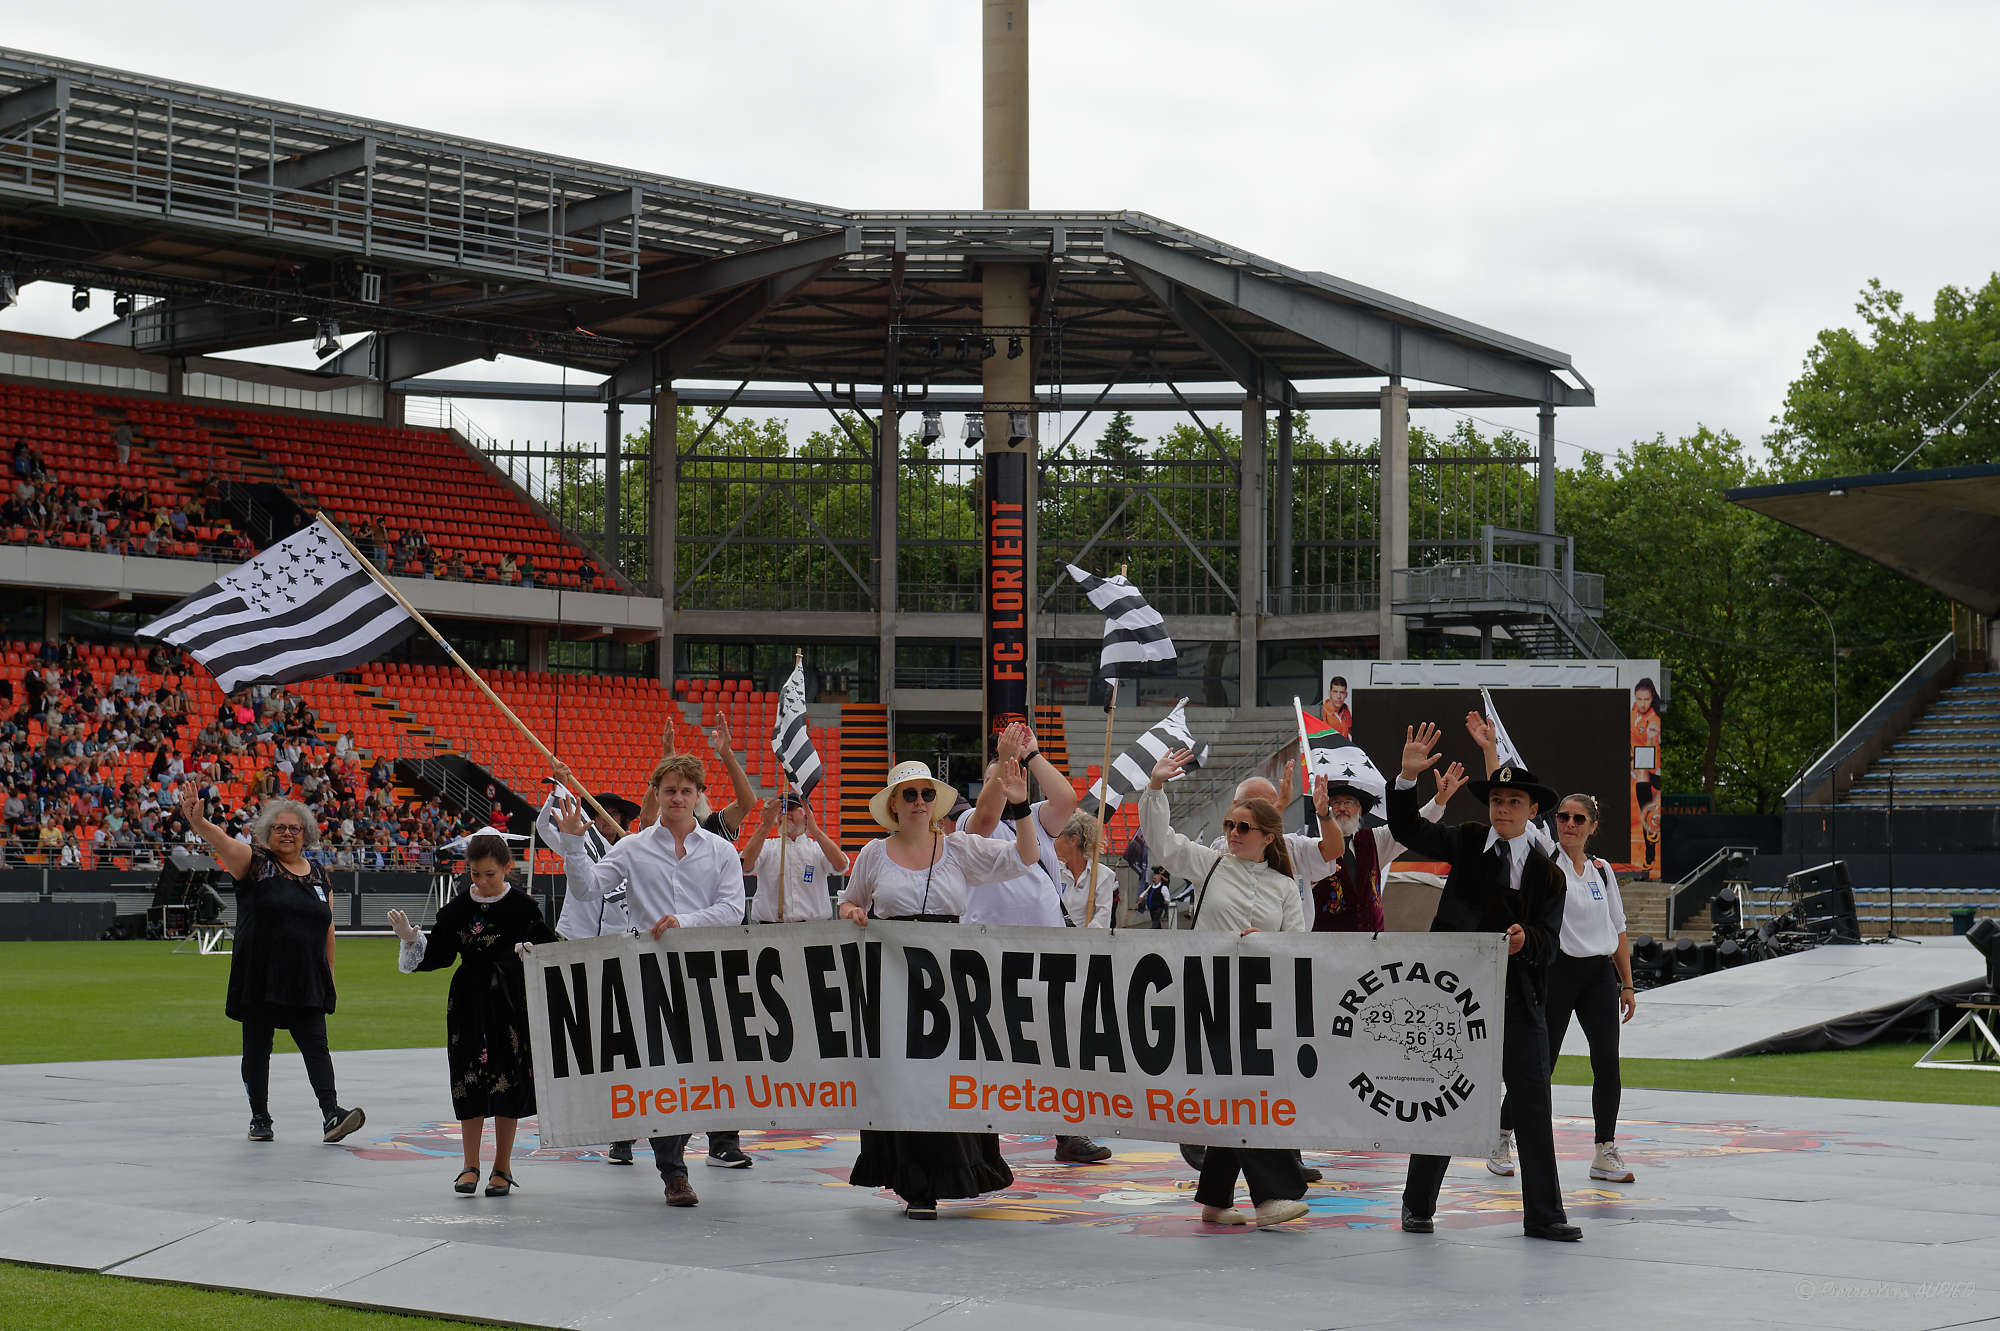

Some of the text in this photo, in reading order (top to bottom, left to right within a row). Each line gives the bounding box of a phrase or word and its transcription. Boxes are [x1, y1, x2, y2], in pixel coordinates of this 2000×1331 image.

[991, 500, 1024, 680] FC LORIENT
[544, 946, 794, 1079] NANTES
[803, 941, 882, 1060] EN
[902, 945, 1275, 1077] BRETAGNE
[1332, 961, 1487, 1042] BRETAGNE
[1369, 1010, 1393, 1024] 29
[1404, 1010, 1426, 1024] 22
[1434, 1022, 1456, 1036] 35
[1405, 1031, 1427, 1046] 56
[1432, 1047, 1454, 1061] 44
[610, 1074, 857, 1120] Breizh Unvan
[948, 1073, 1297, 1127] Bretagne Réunie
